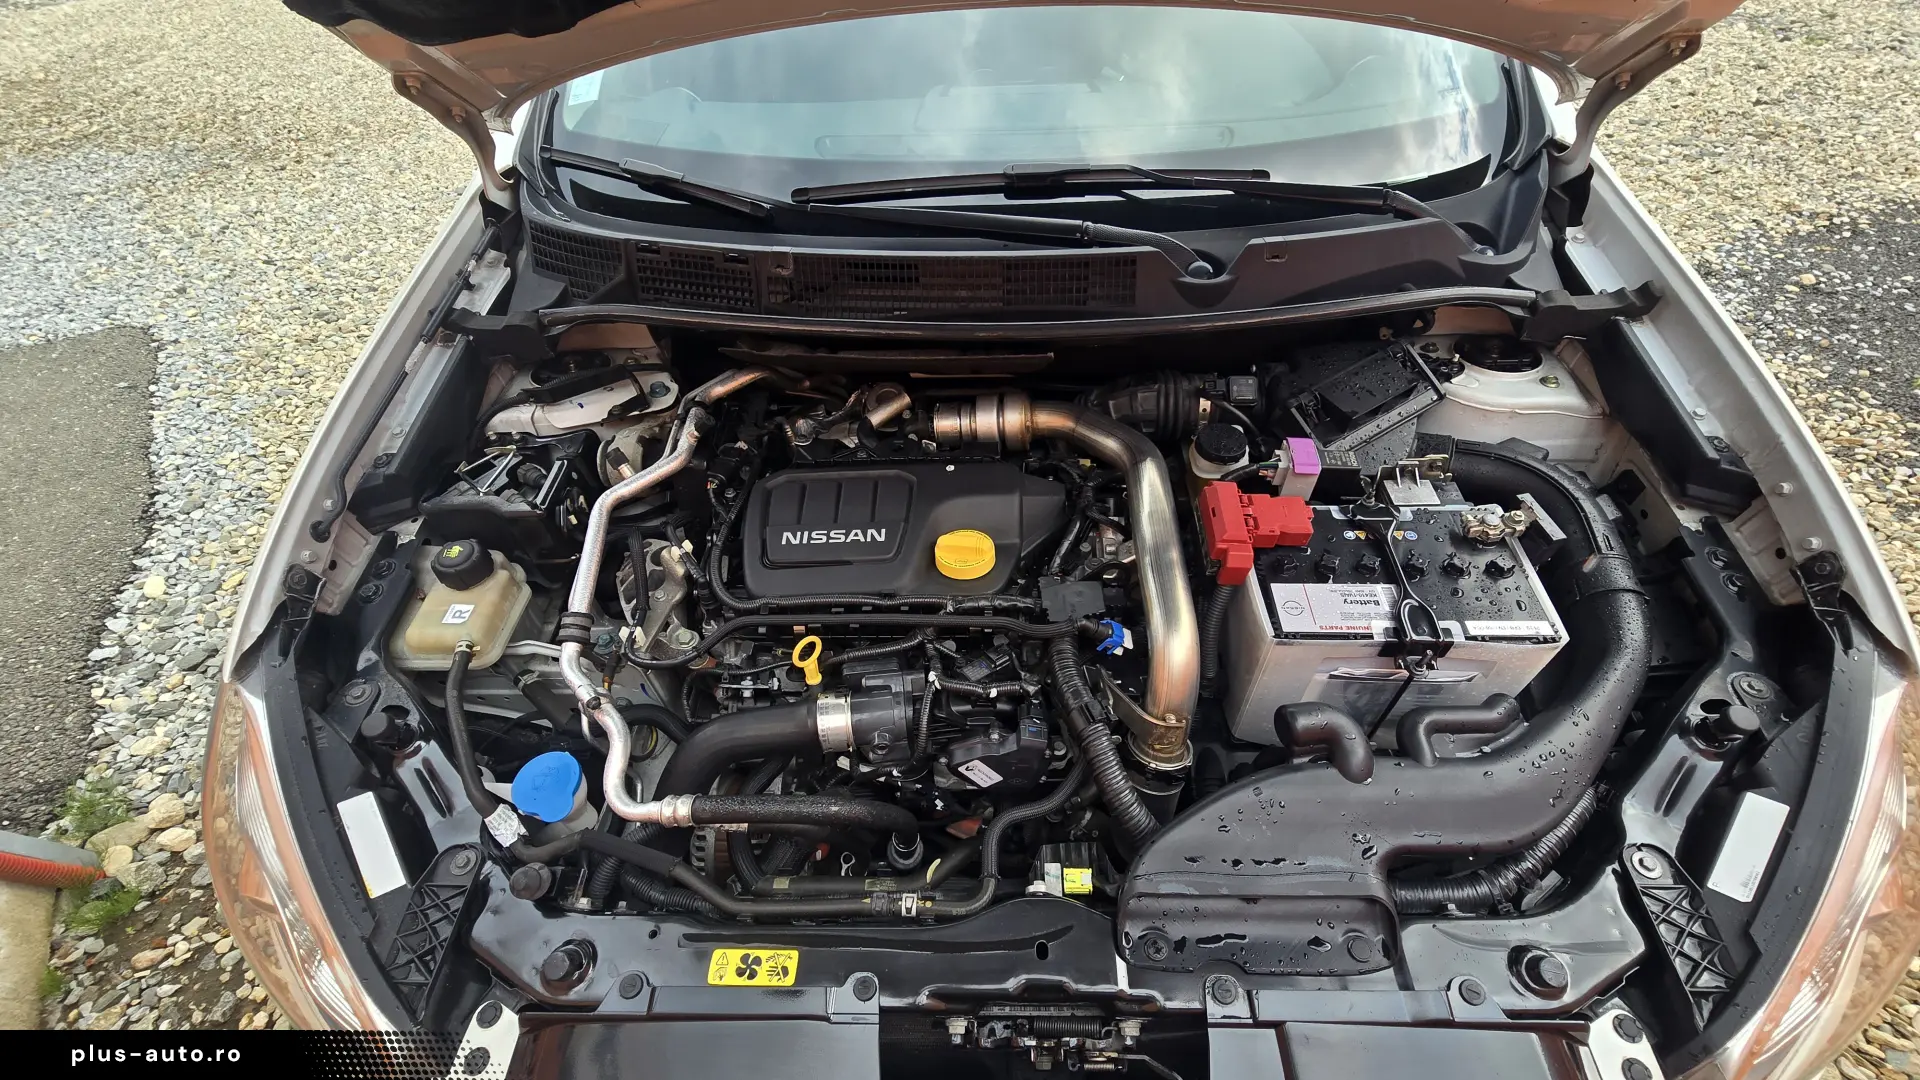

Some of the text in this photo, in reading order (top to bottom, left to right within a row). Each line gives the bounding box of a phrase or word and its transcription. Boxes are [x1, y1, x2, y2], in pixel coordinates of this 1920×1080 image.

[781, 528, 886, 545] NISSAN
[1343, 598, 1381, 606] Battery
[451, 609, 471, 619] R
